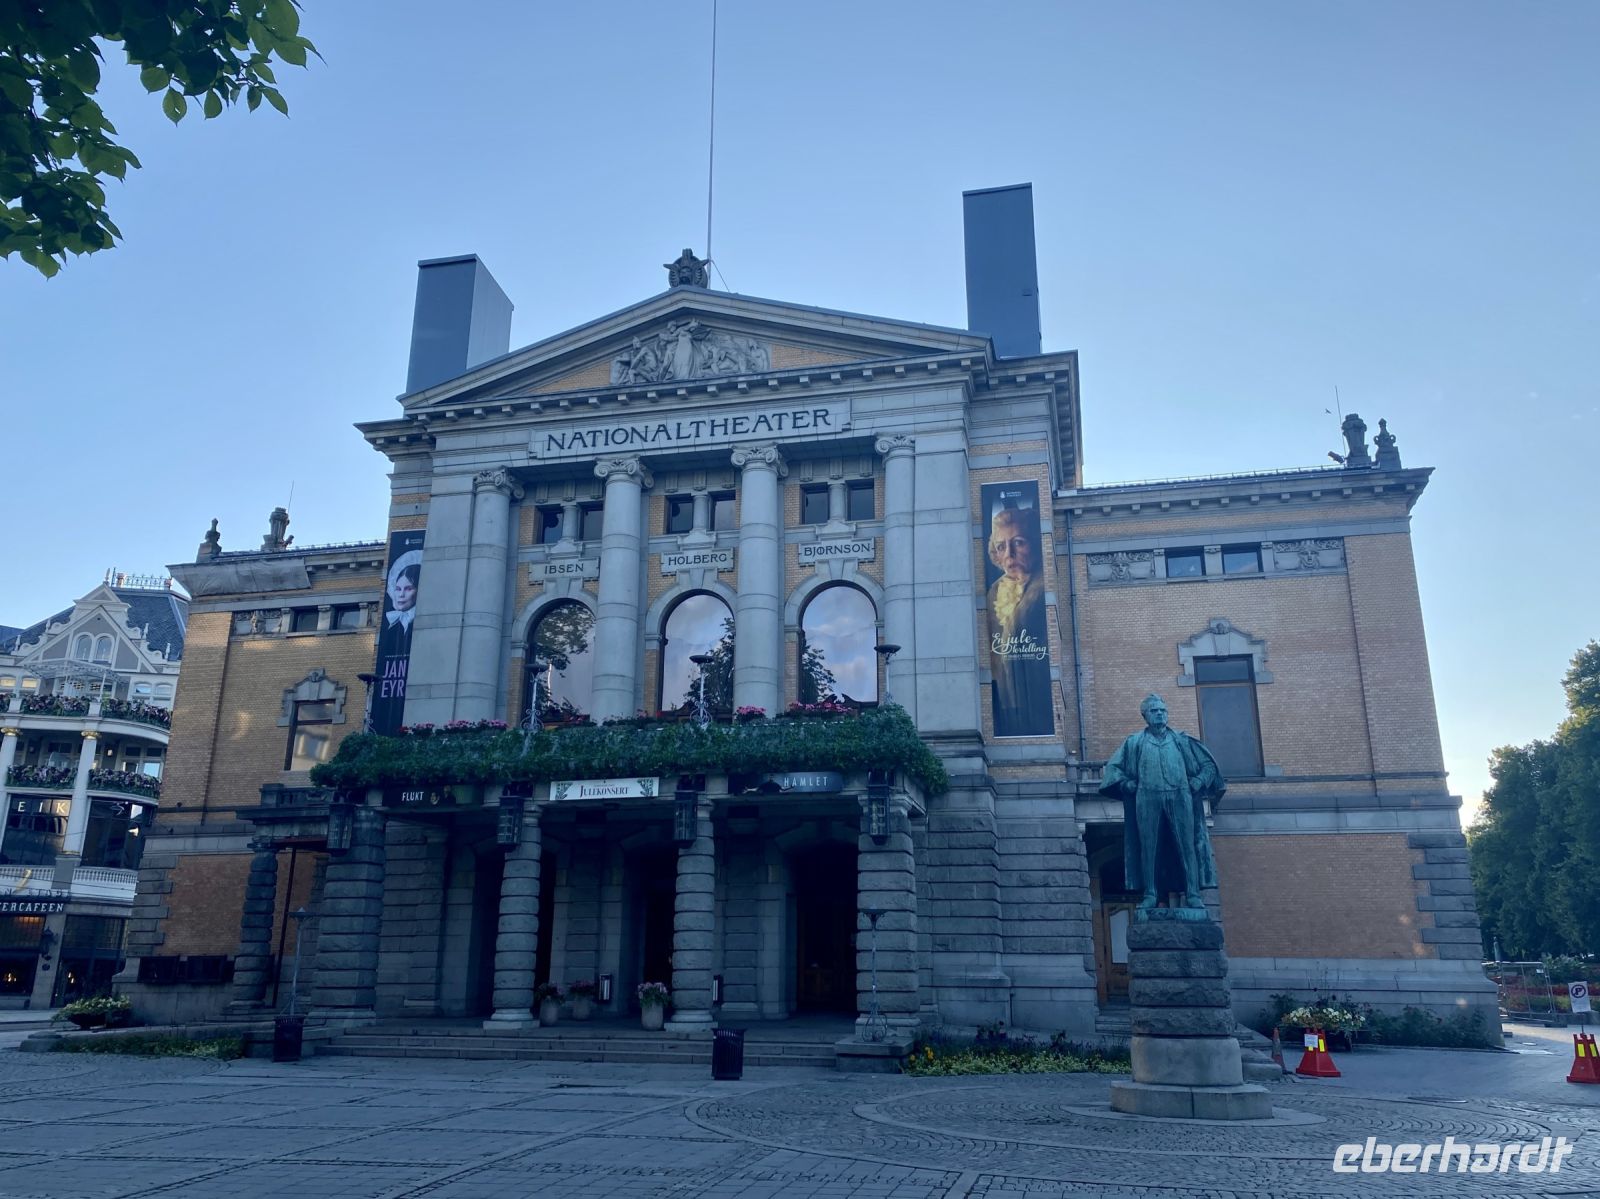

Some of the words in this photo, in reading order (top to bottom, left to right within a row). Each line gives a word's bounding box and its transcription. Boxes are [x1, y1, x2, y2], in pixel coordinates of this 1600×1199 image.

[547, 408, 831, 451] NATIONALTHEATER
[804, 543, 871, 557] BJØRNSON
[668, 553, 727, 566] HOLBERG
[544, 563, 584, 575] IBSEN
[382, 660, 407, 678] JAN
[381, 679, 405, 698] EYR
[784, 776, 828, 787] HAMLET
[402, 791, 424, 801] FLUKT
[0, 902, 64, 912] ERCAFEEN
